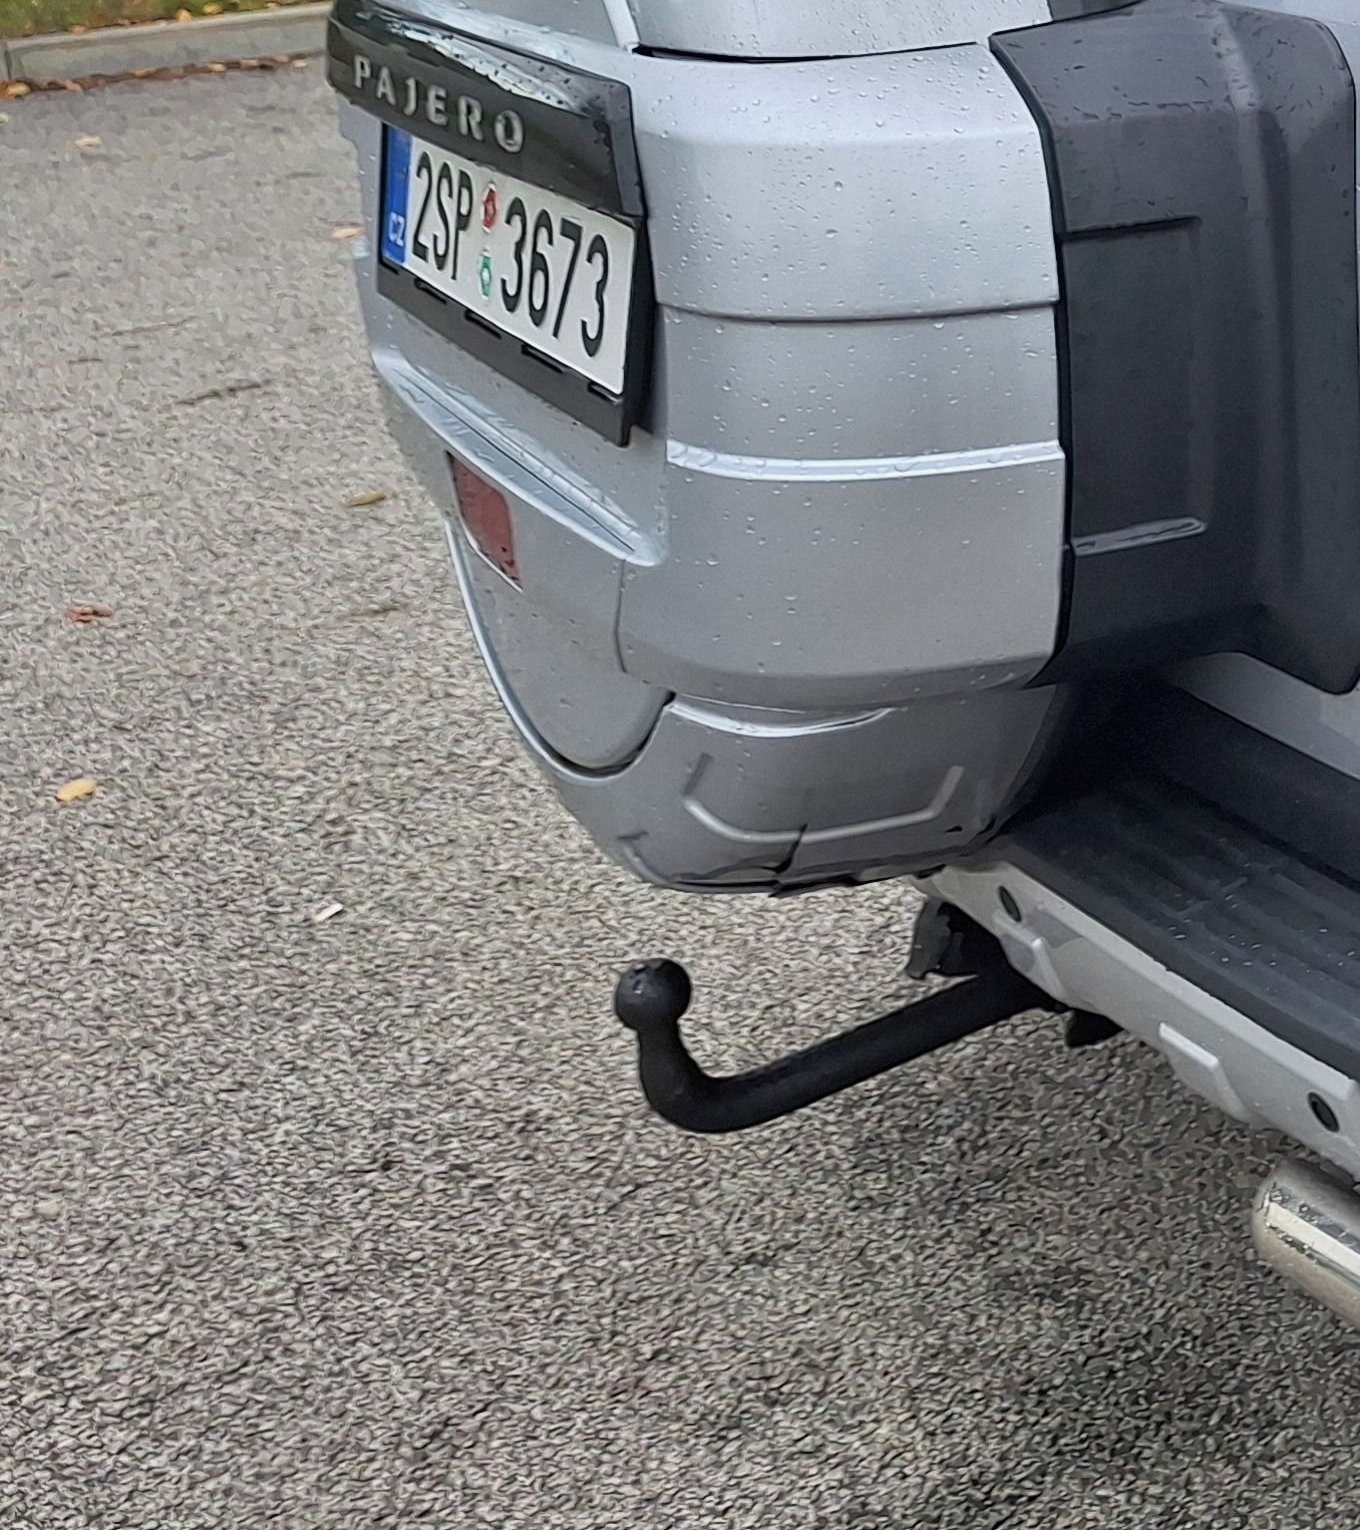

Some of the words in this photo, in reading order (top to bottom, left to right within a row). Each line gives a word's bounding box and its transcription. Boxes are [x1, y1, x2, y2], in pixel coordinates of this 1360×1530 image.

[353, 53, 525, 154] PAJERO
[388, 211, 406, 247] CZ
[412, 150, 474, 281] 2SP
[500, 196, 610, 358] 3673
